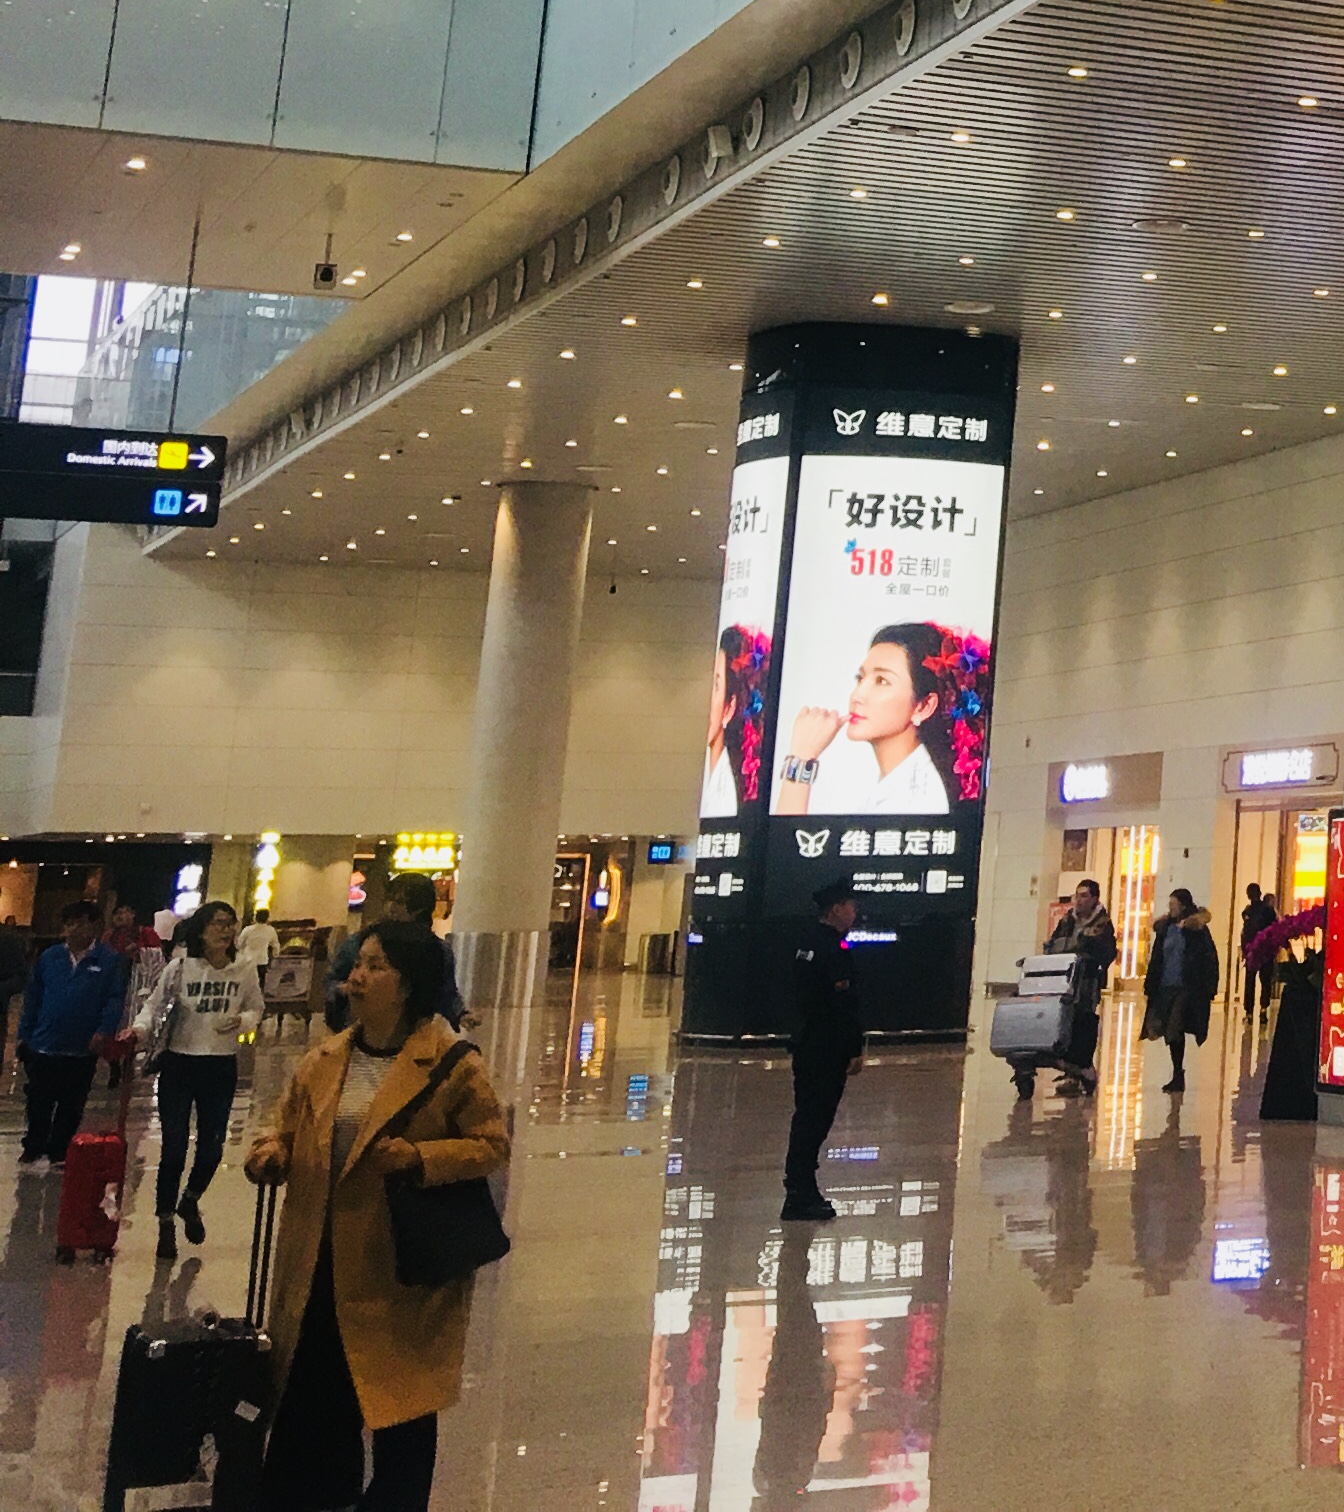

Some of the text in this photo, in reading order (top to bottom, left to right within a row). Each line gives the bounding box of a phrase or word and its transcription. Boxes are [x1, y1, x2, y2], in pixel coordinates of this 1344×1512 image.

[875, 411, 988, 442] 维意定制
[66, 452, 158, 468] Domestic Arrivals
[102, 439, 158, 456] 国内到达
[851, 548, 894, 576] 518
[898, 555, 940, 578] 定制
[840, 829, 956, 857] 维意定制
